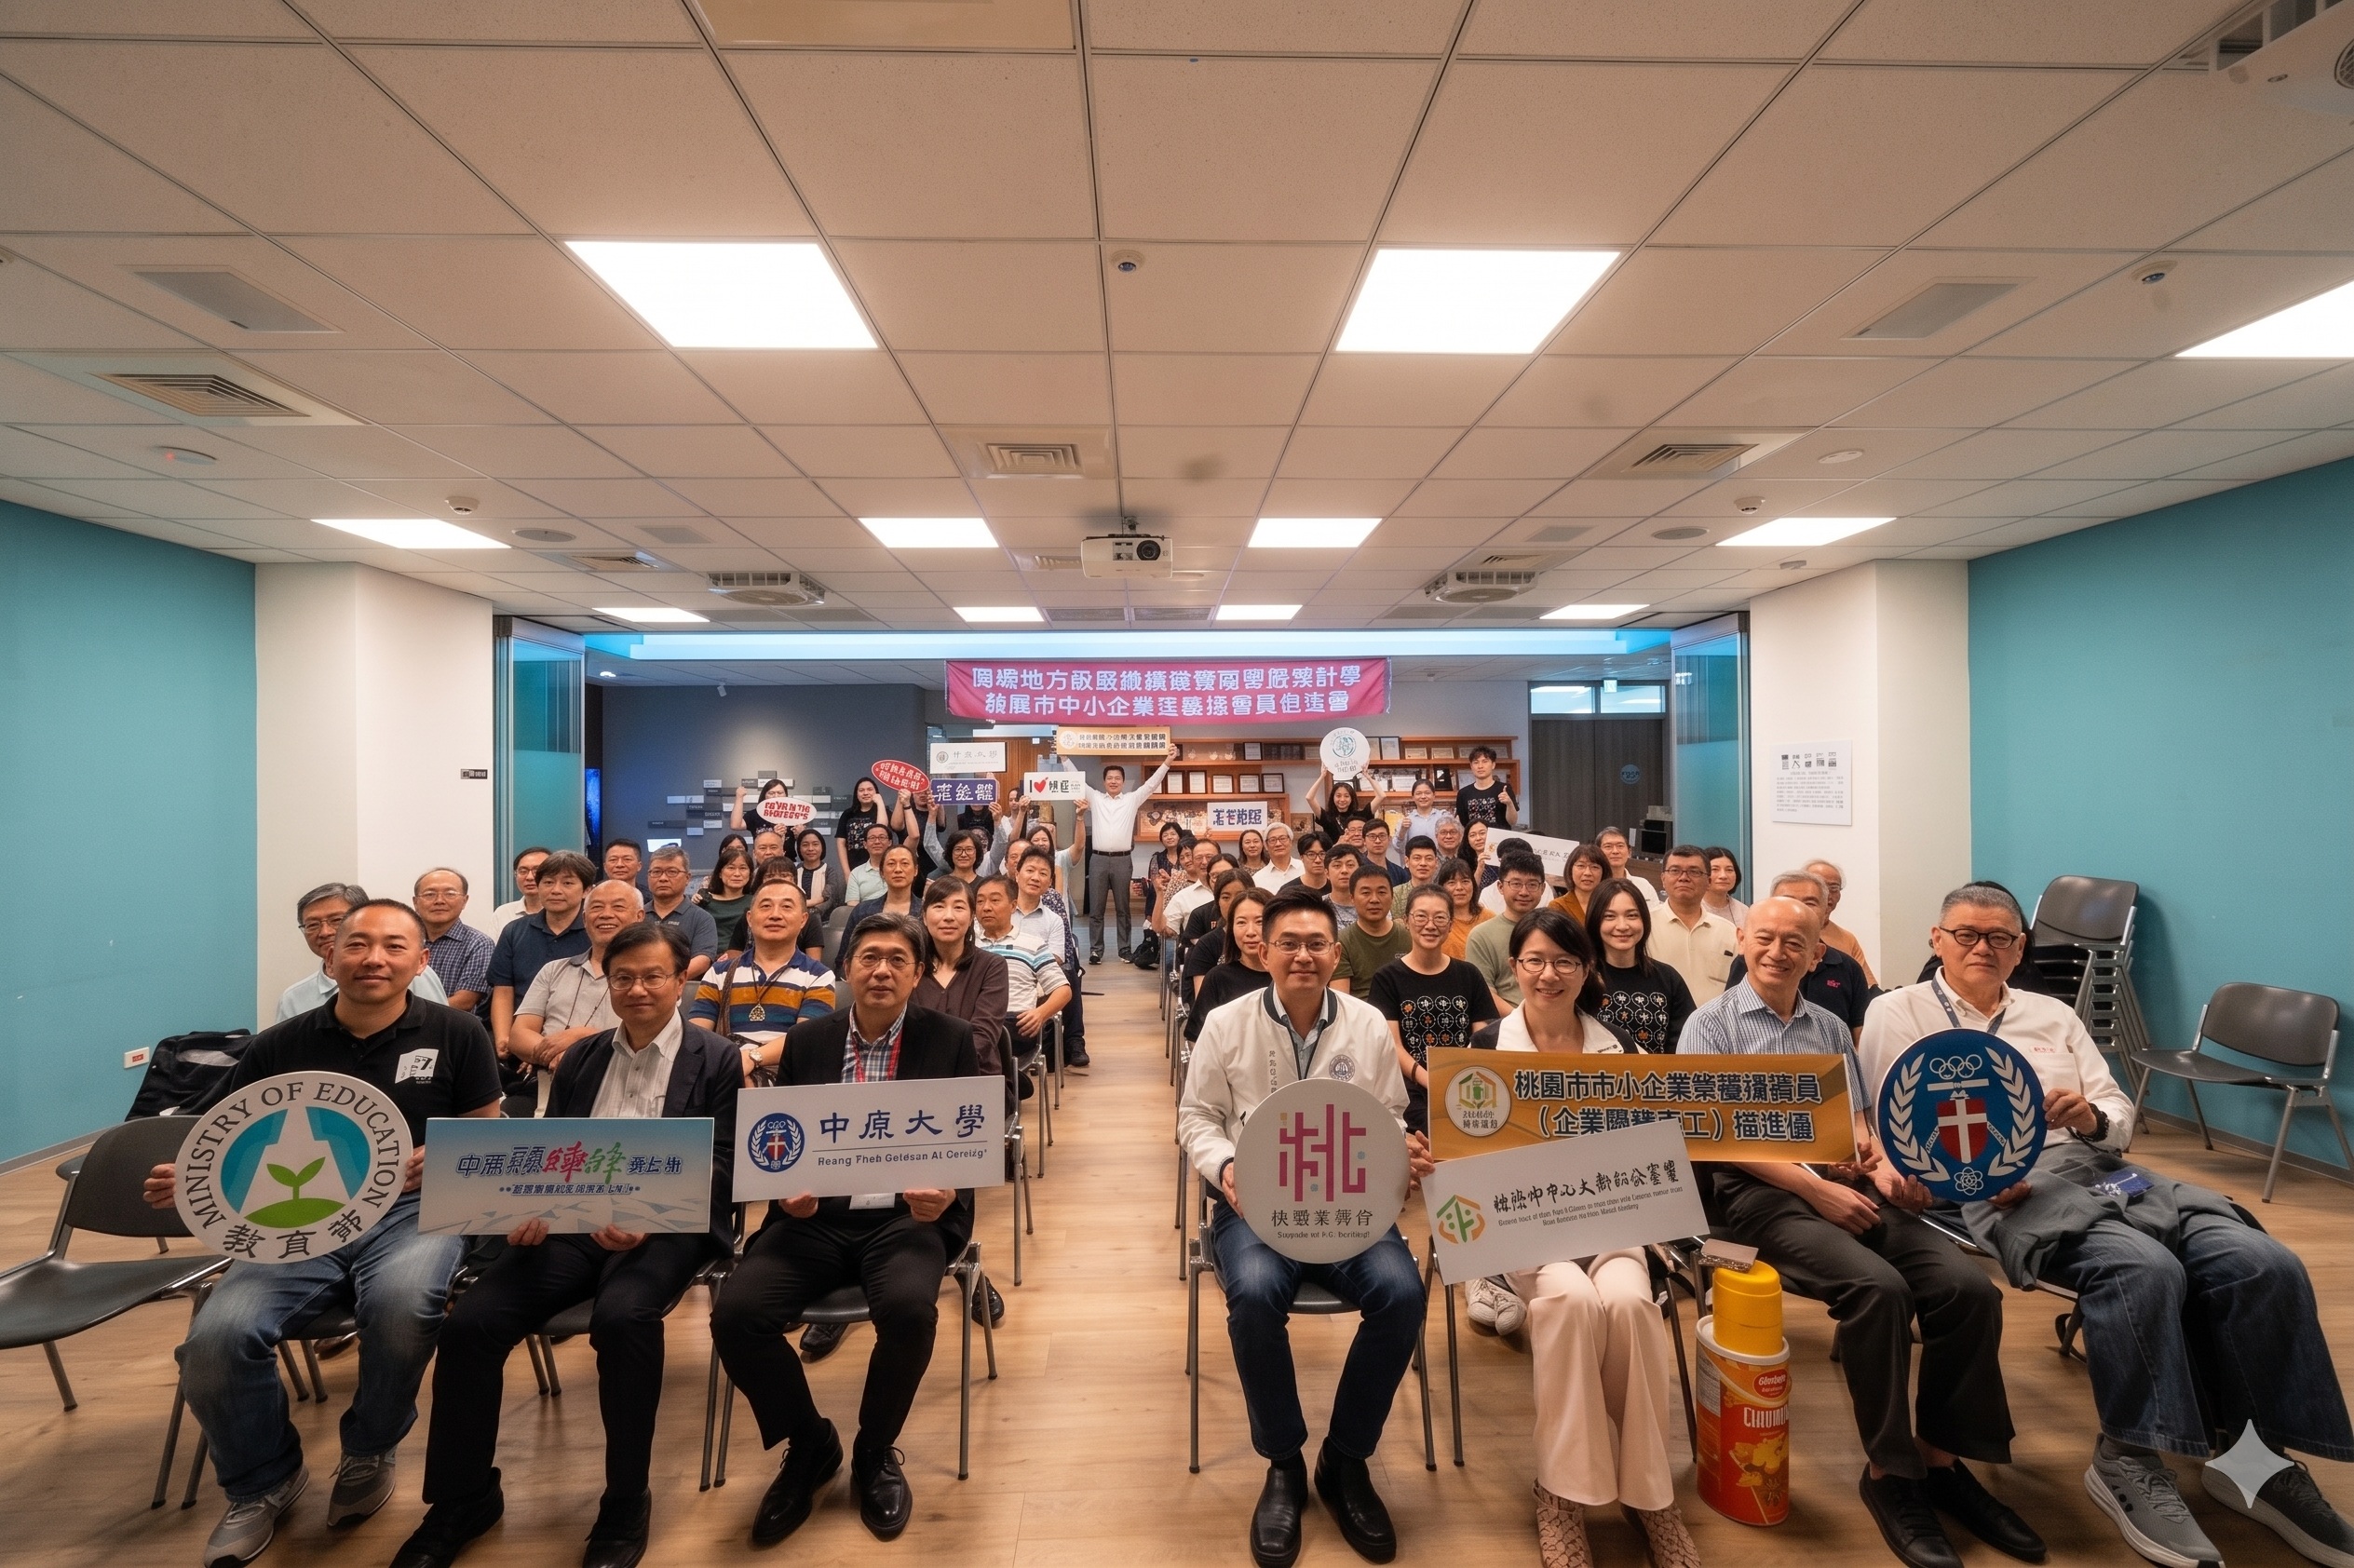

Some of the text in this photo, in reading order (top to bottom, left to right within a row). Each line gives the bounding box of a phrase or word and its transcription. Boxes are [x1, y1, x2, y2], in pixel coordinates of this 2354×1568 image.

[186, 1082, 400, 1229] MINISTRY OF EDUCATION
[819, 1104, 985, 1143] 中原大學
